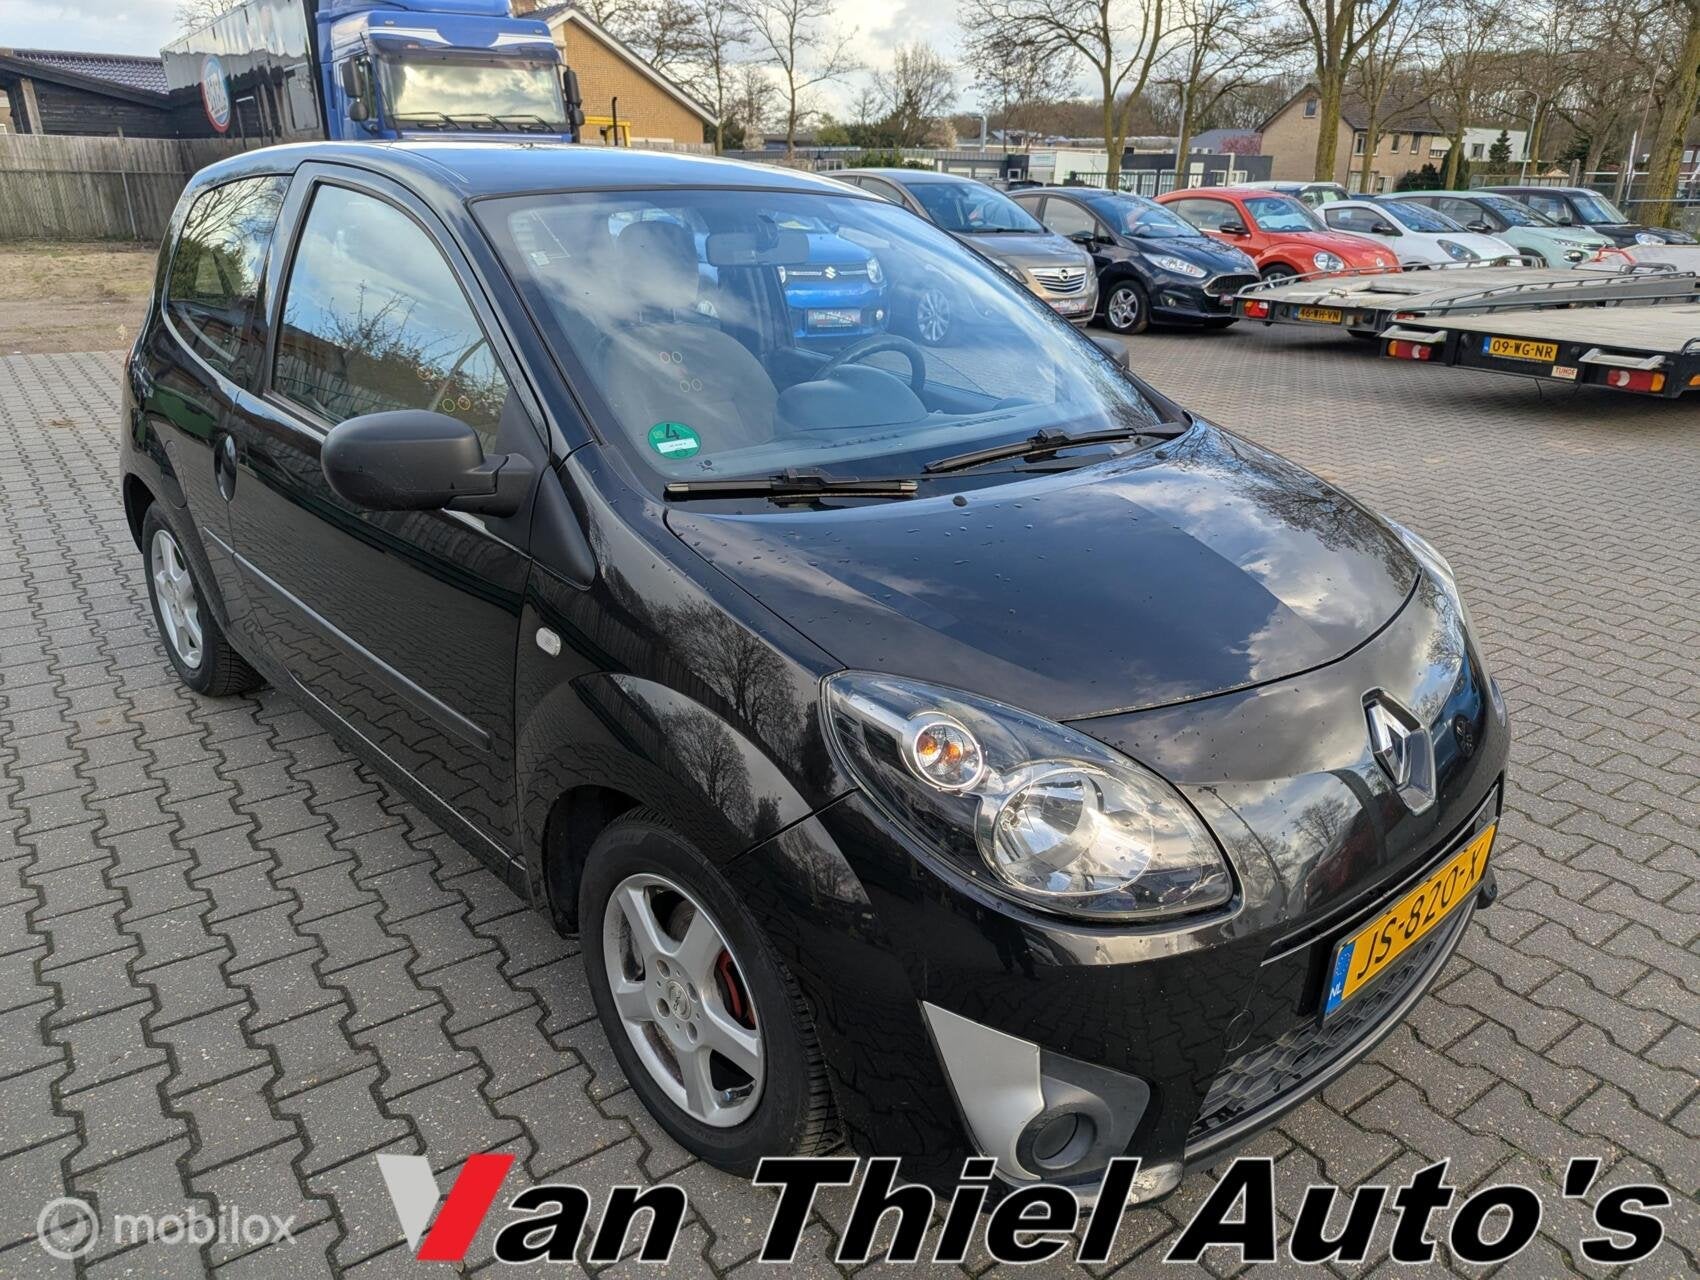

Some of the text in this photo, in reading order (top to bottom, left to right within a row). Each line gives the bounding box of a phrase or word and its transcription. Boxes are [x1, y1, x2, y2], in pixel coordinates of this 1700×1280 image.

[1492, 340, 1554, 359] 09-WG-NR
[665, 423, 681, 440] 4
[1356, 842, 1484, 981] JS-820-X
[1328, 981, 1343, 1001] NL
